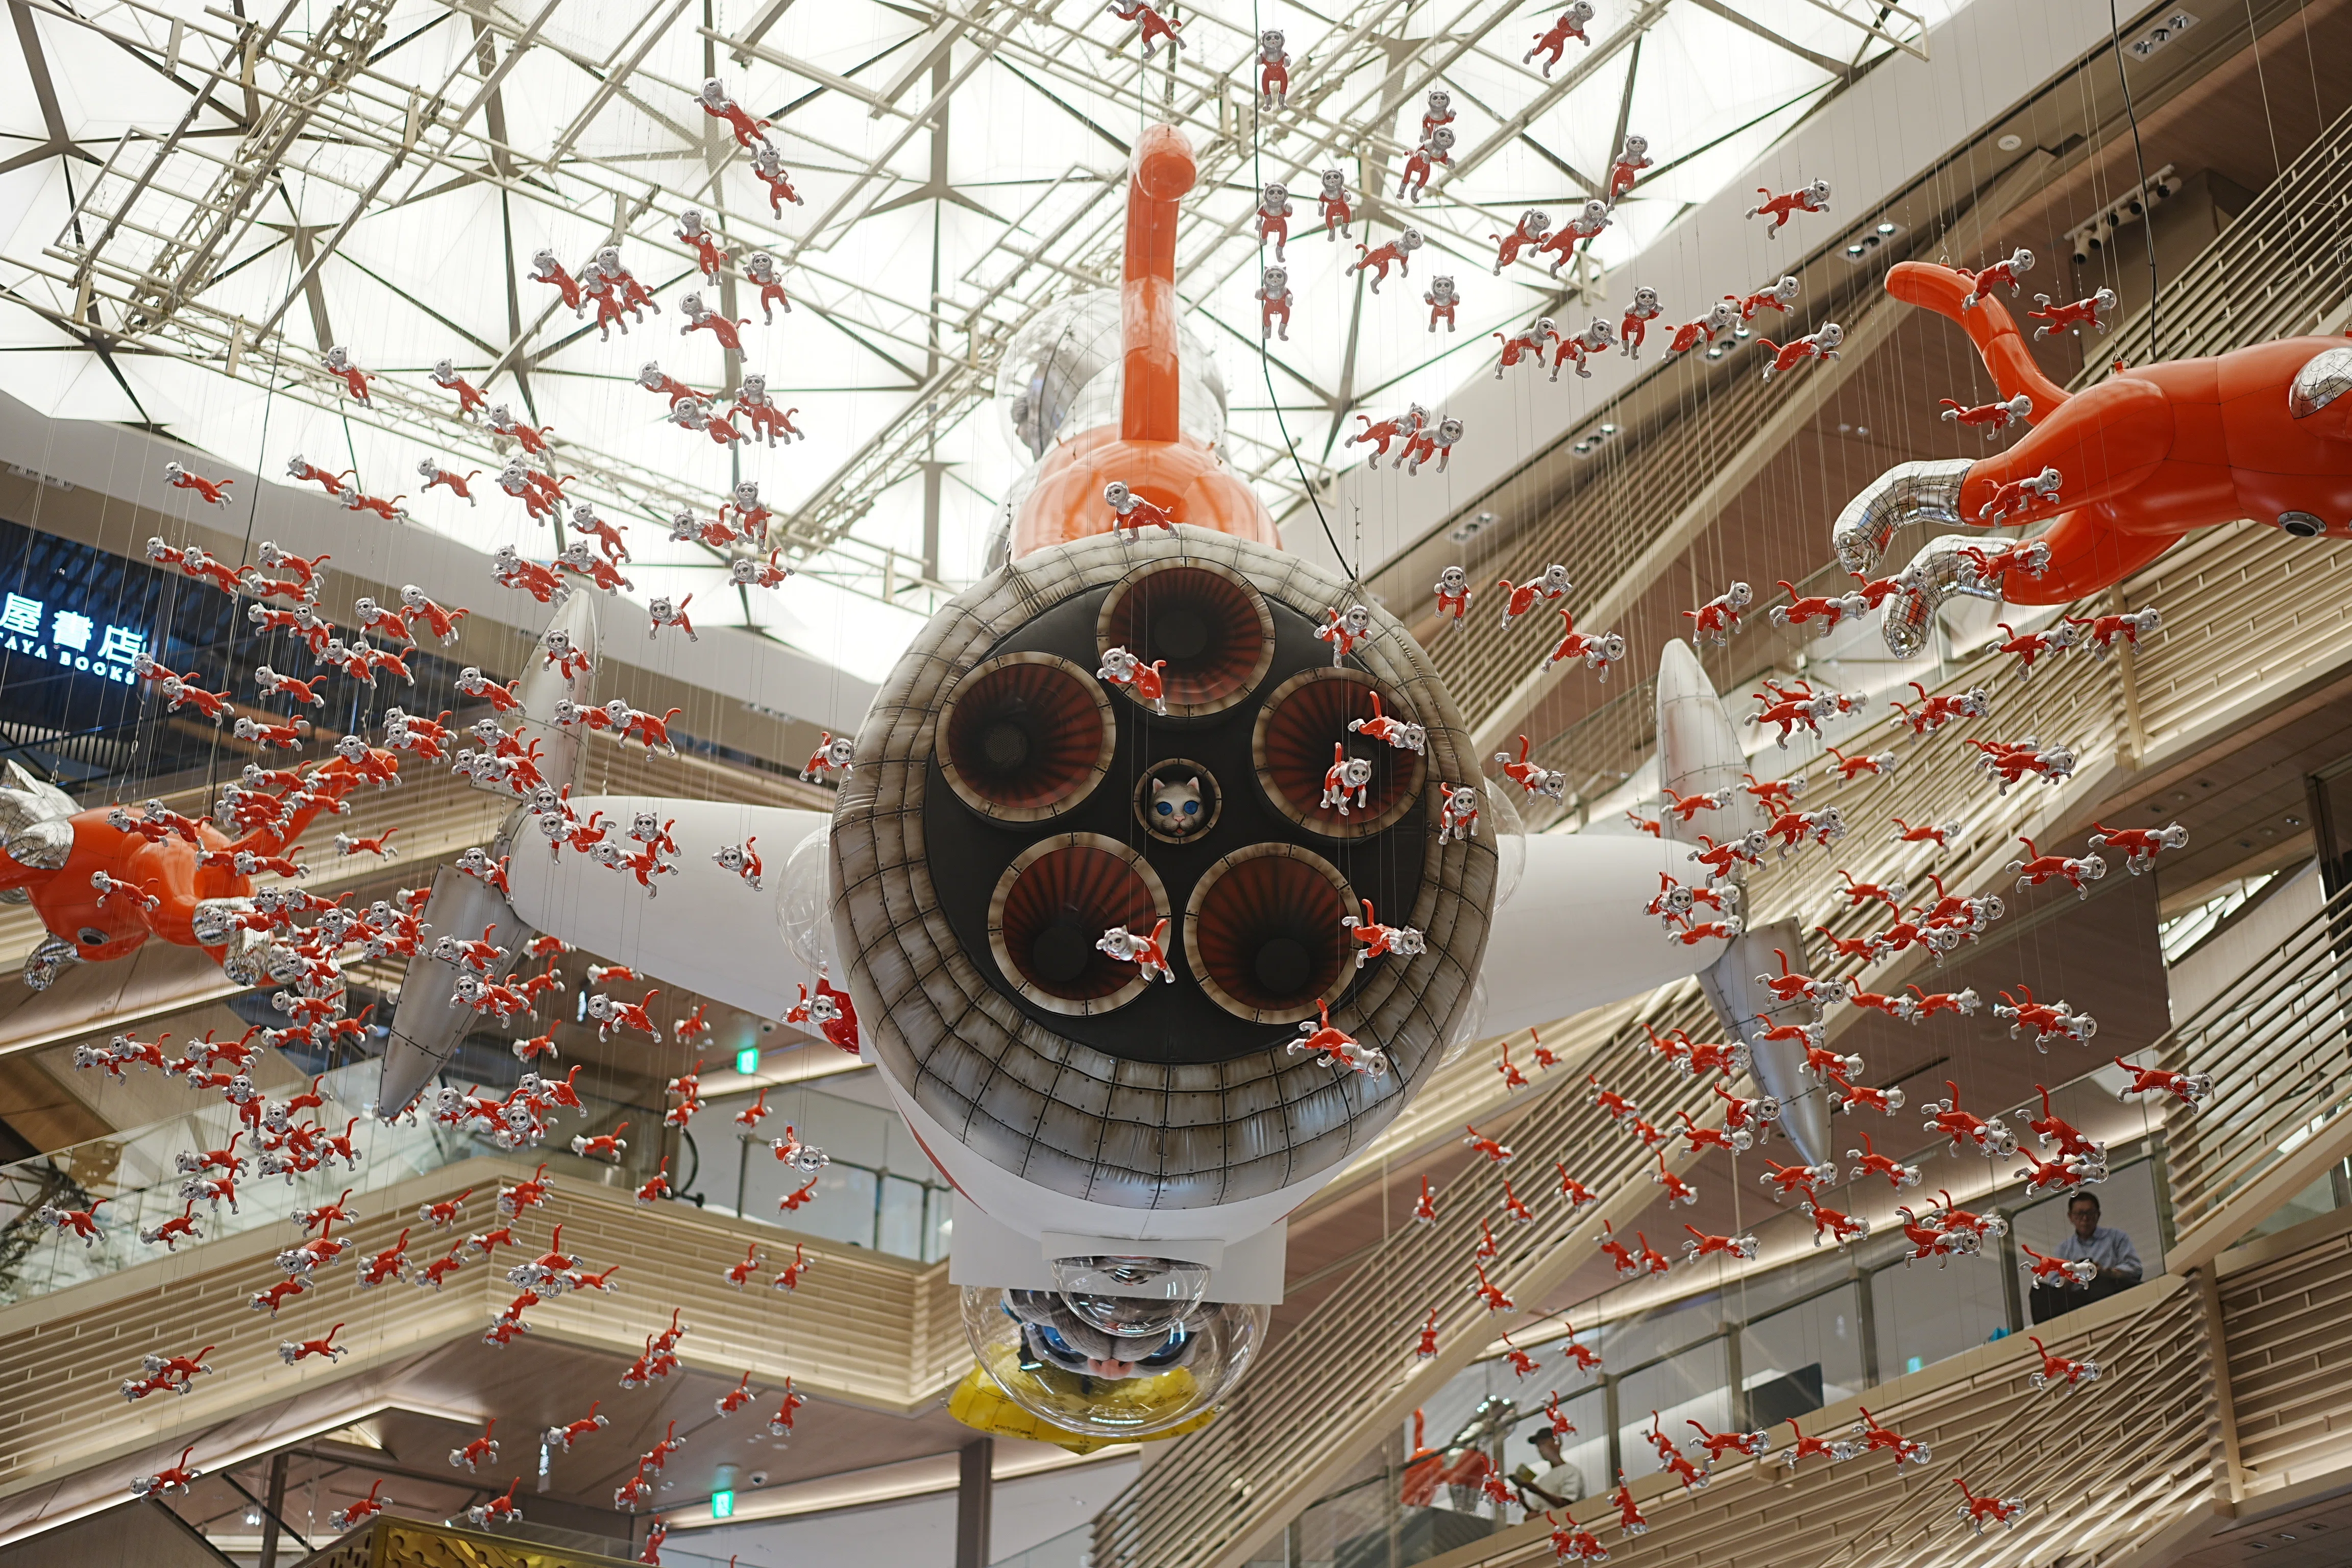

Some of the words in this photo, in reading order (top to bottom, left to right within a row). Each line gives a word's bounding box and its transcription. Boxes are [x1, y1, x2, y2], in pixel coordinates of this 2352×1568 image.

[0, 592, 142, 667] 屋書店
[59, 651, 135, 685] BOOKS
